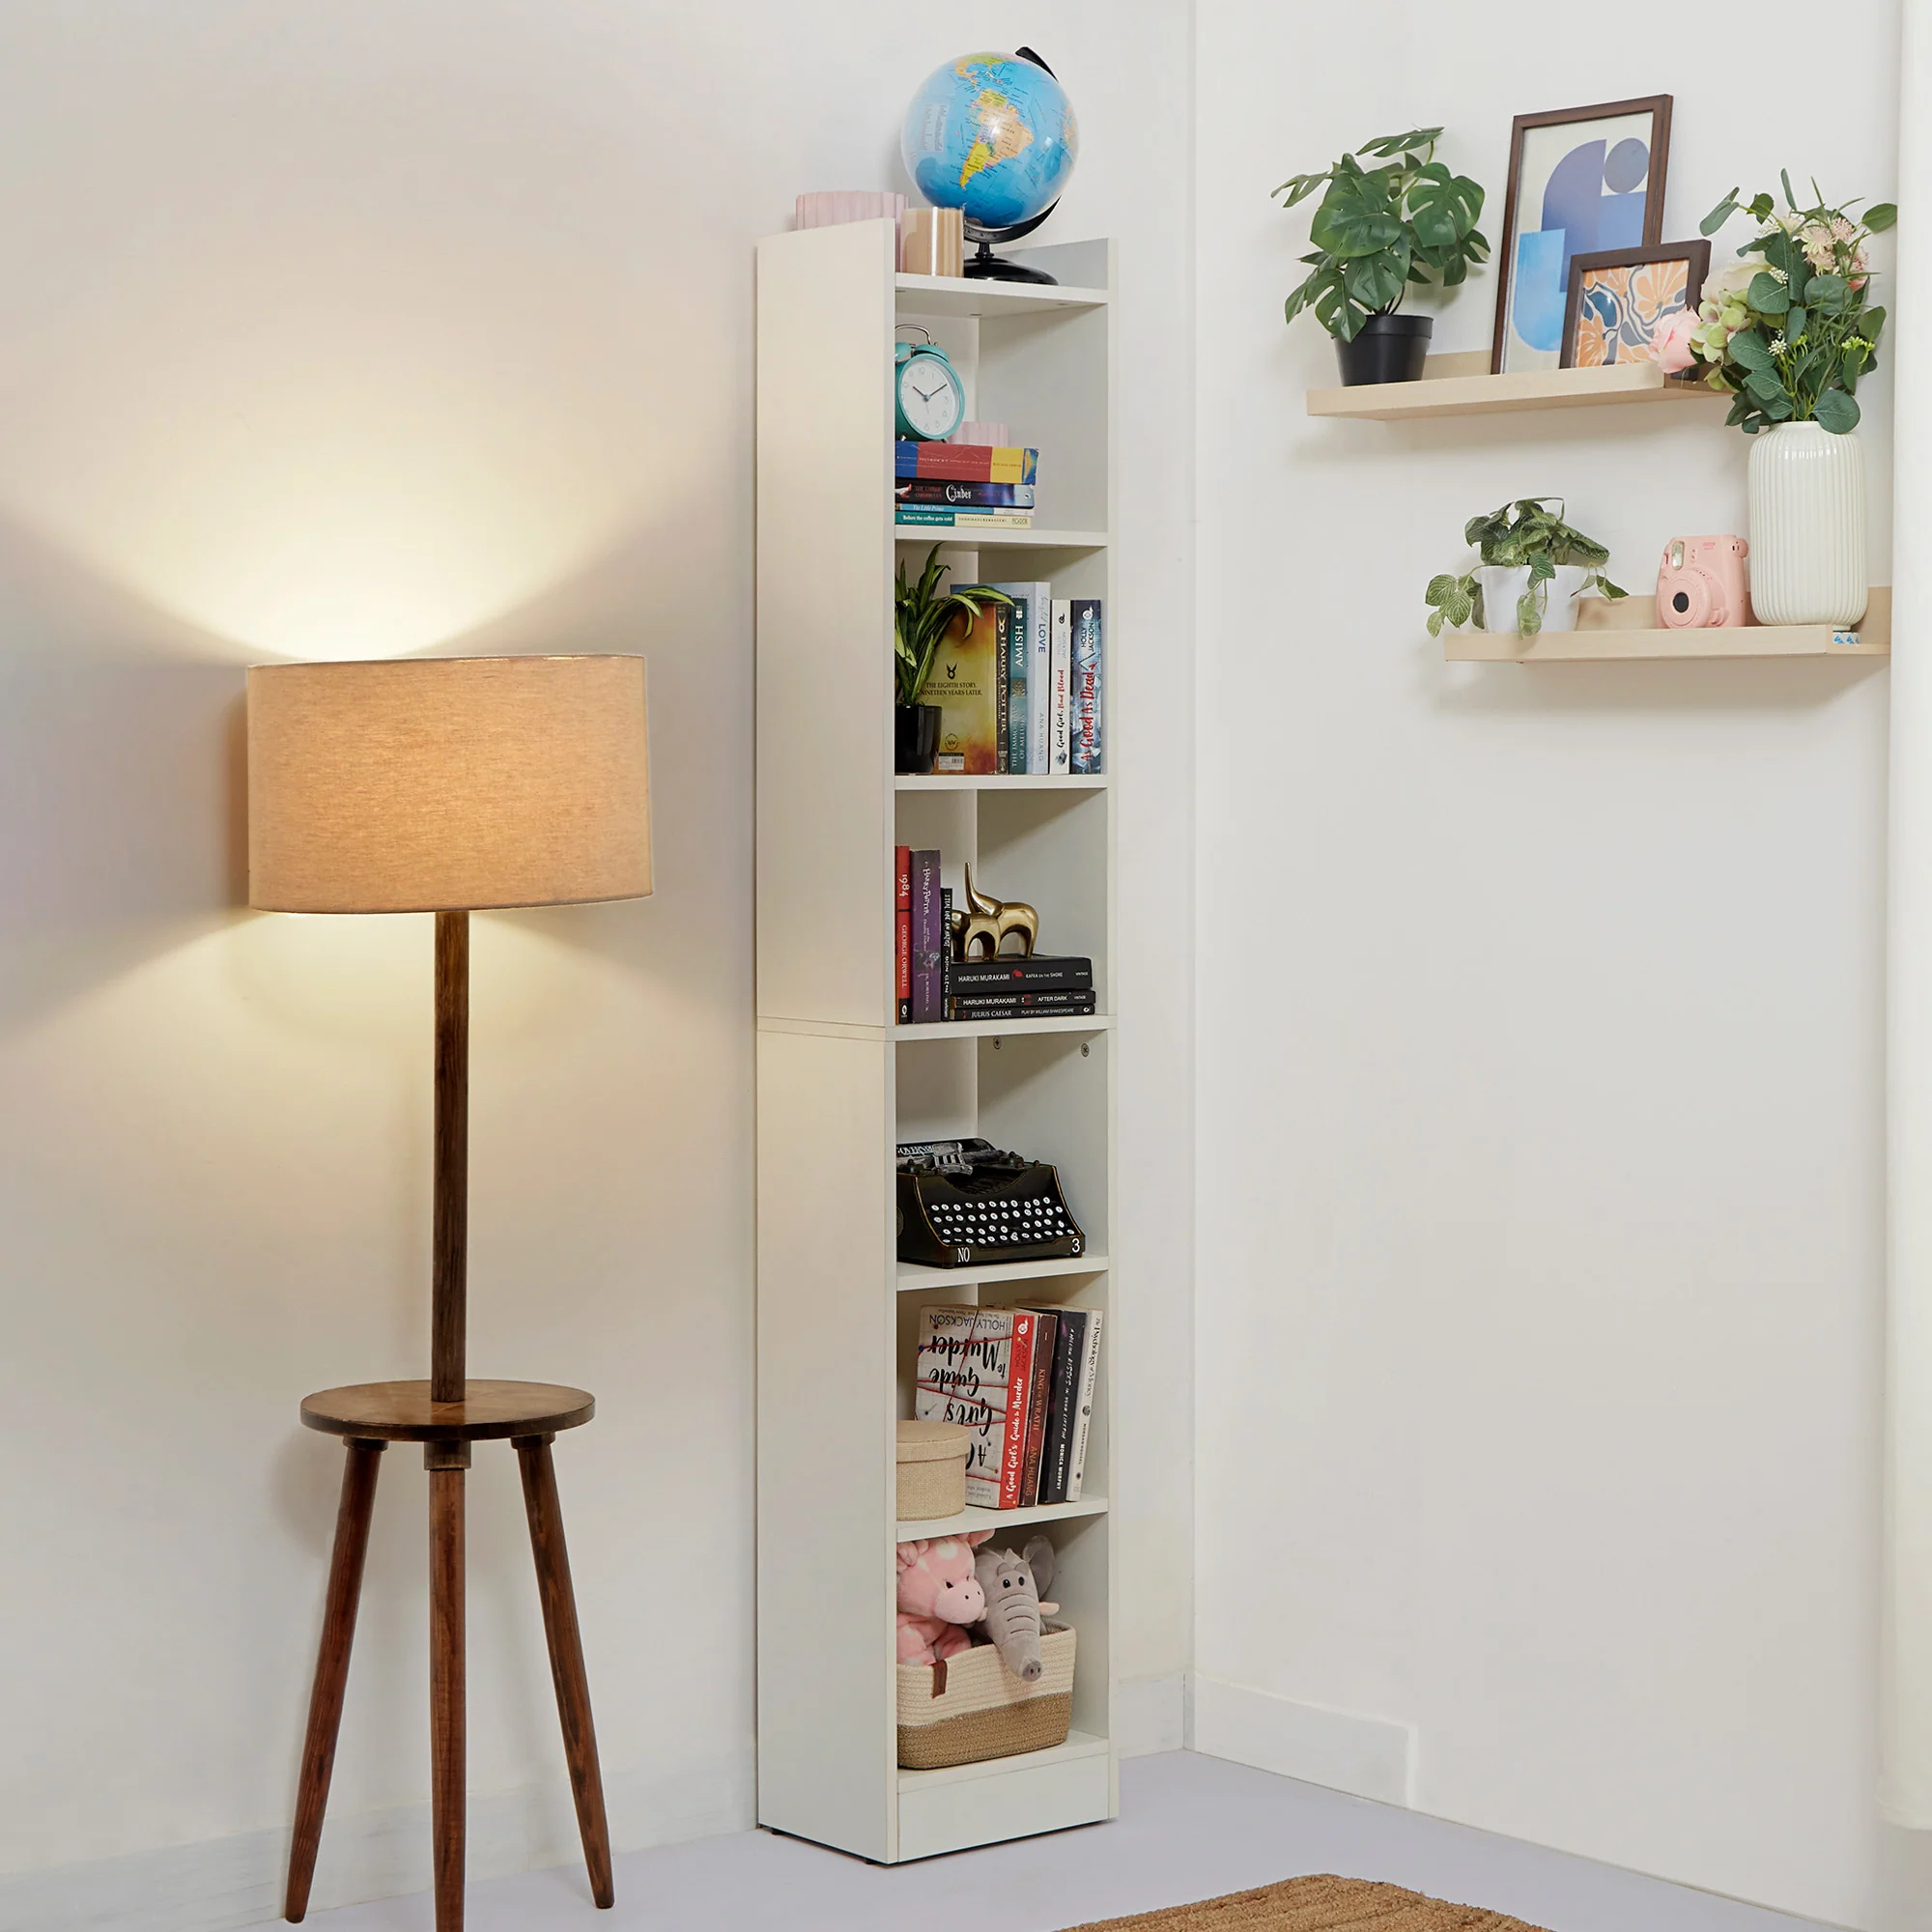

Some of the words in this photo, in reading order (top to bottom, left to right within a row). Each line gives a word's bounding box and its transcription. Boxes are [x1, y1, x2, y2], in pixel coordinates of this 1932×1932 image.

[946, 485, 972, 502] Cinder
[1080, 672, 1094, 699] Dead
[1082, 702, 1093, 714] As
[1079, 717, 1094, 748] Good
[1020, 750, 1024, 759] OF
[1081, 751, 1094, 761] As
[899, 874, 910, 896] 1984
[957, 1247, 970, 1262] NO
[1072, 1238, 1080, 1253] 3
[929, 1315, 975, 1327] JACKSON
[977, 1319, 1005, 1330] HOLLY
[927, 1336, 1000, 1372] Murder
[1089, 1327, 1100, 1366] Psychology
[929, 1367, 980, 1397] Guide
[997, 1364, 1006, 1378] to
[1012, 1378, 1023, 1409] Murder
[1085, 1372, 1094, 1397] Money
[947, 1398, 992, 1436] Girls
[1034, 1399, 1042, 1430] WRATH
[1010, 1417, 1020, 1440] Guide
[978, 1445, 986, 1466] A
[1008, 1444, 1018, 1468] Girl's
[1006, 1471, 1016, 1492] Good
[1026, 1468, 1035, 1496] HUANG
